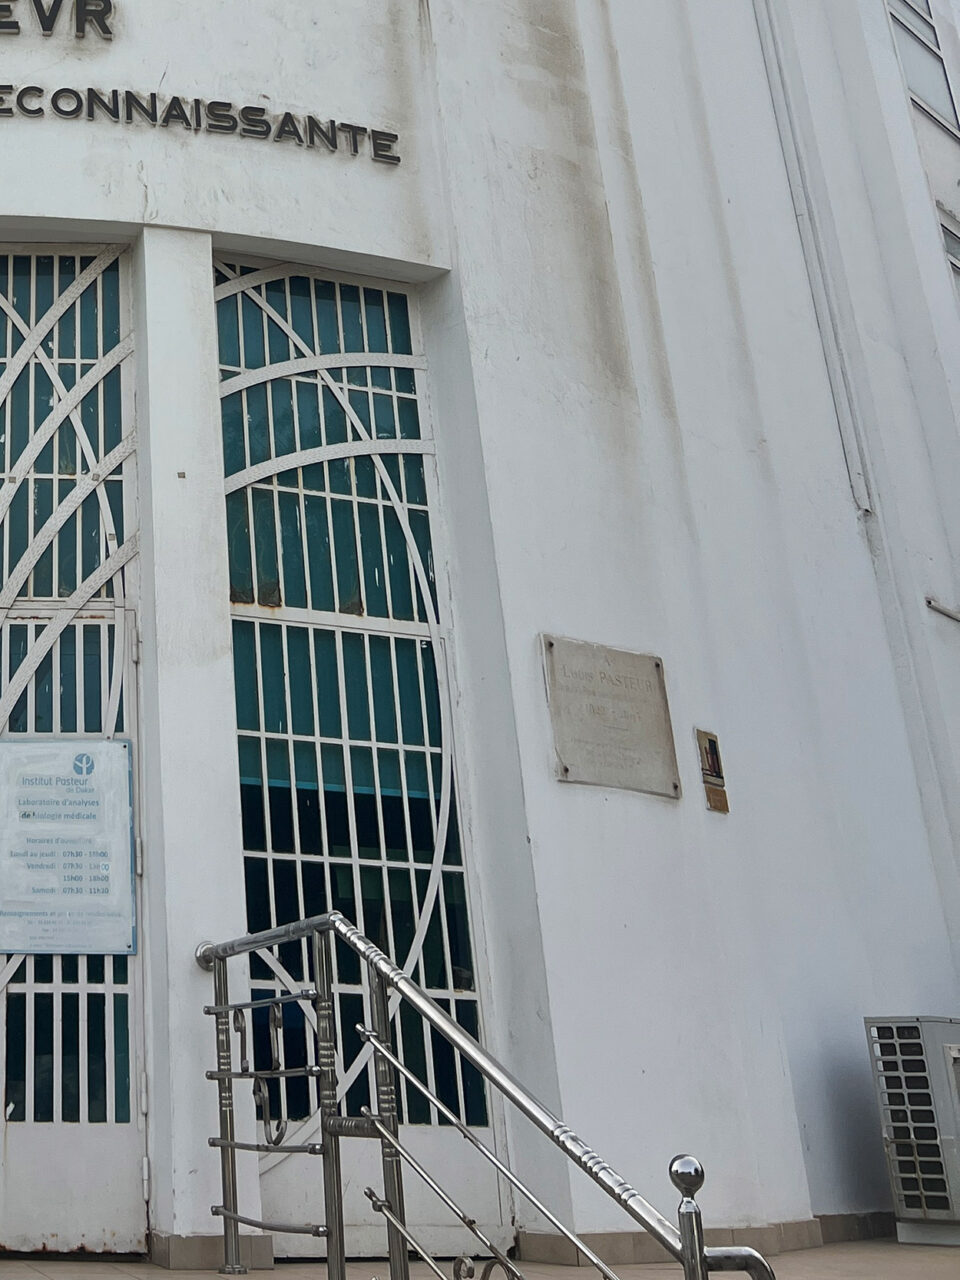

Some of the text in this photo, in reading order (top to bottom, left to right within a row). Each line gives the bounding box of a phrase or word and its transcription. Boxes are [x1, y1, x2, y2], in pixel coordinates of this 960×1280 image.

[599, 671, 654, 693] PASTEUR
[22, 776, 89, 786] Institut Pasteur
[18, 797, 100, 808] Laboratoire d'analyses
[21, 811, 31, 820] de
[63, 811, 97, 820] médicale
